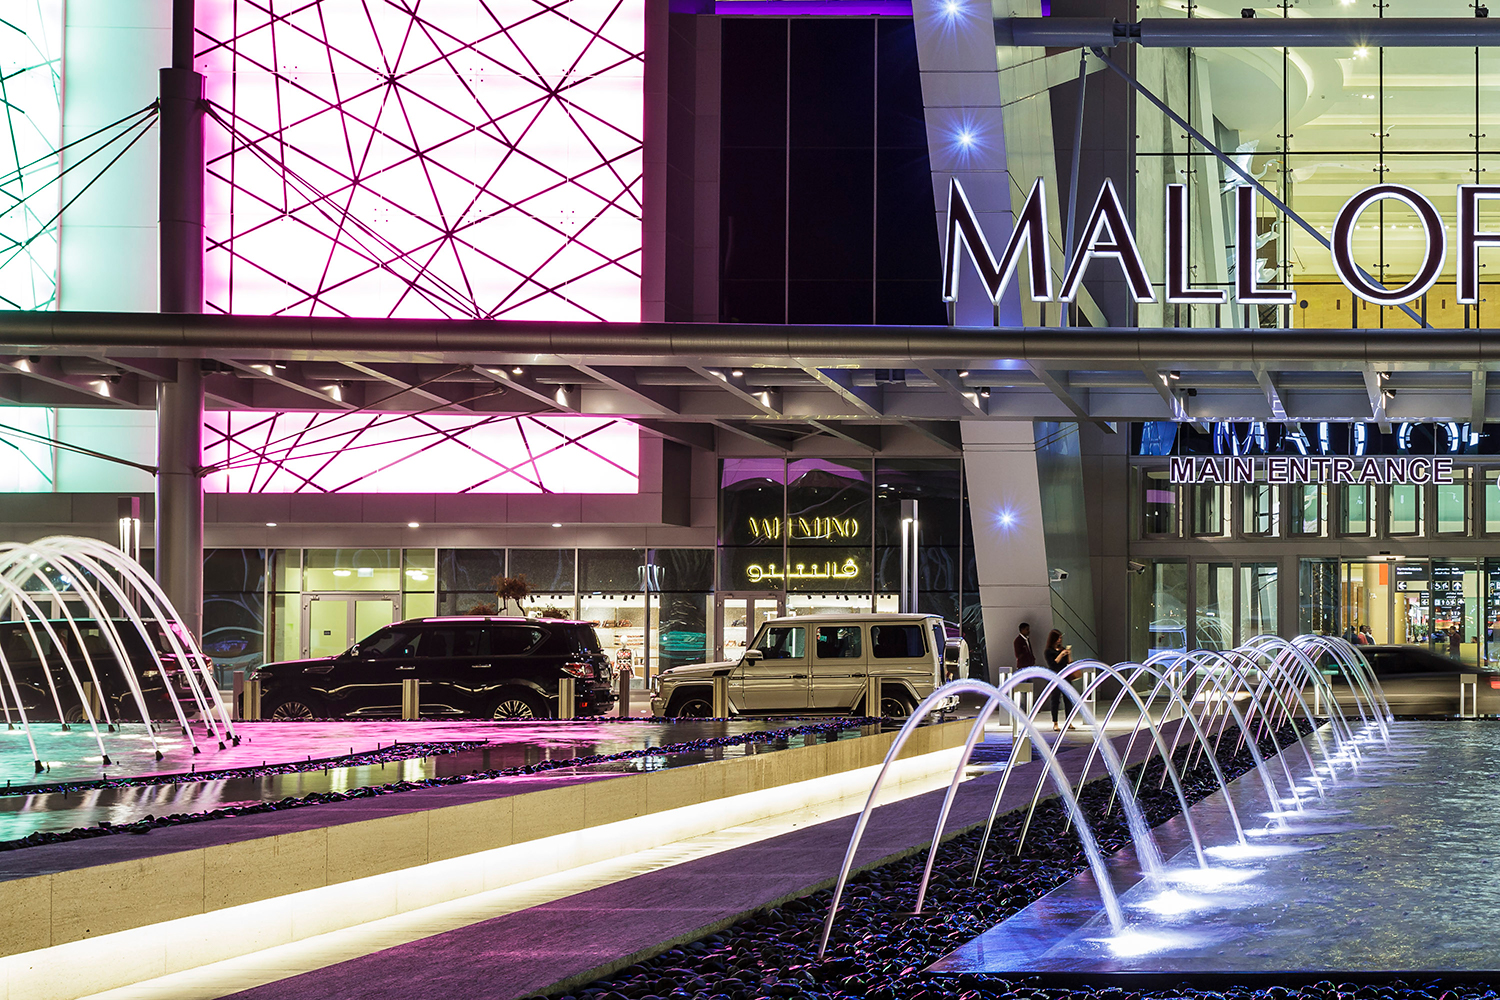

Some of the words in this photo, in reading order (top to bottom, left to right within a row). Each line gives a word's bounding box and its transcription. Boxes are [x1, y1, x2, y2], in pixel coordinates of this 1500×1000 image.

[941, 175, 1297, 305] MALL
[1169, 456, 1256, 485] MAIN
[1267, 456, 1454, 485] ENTRANCE
